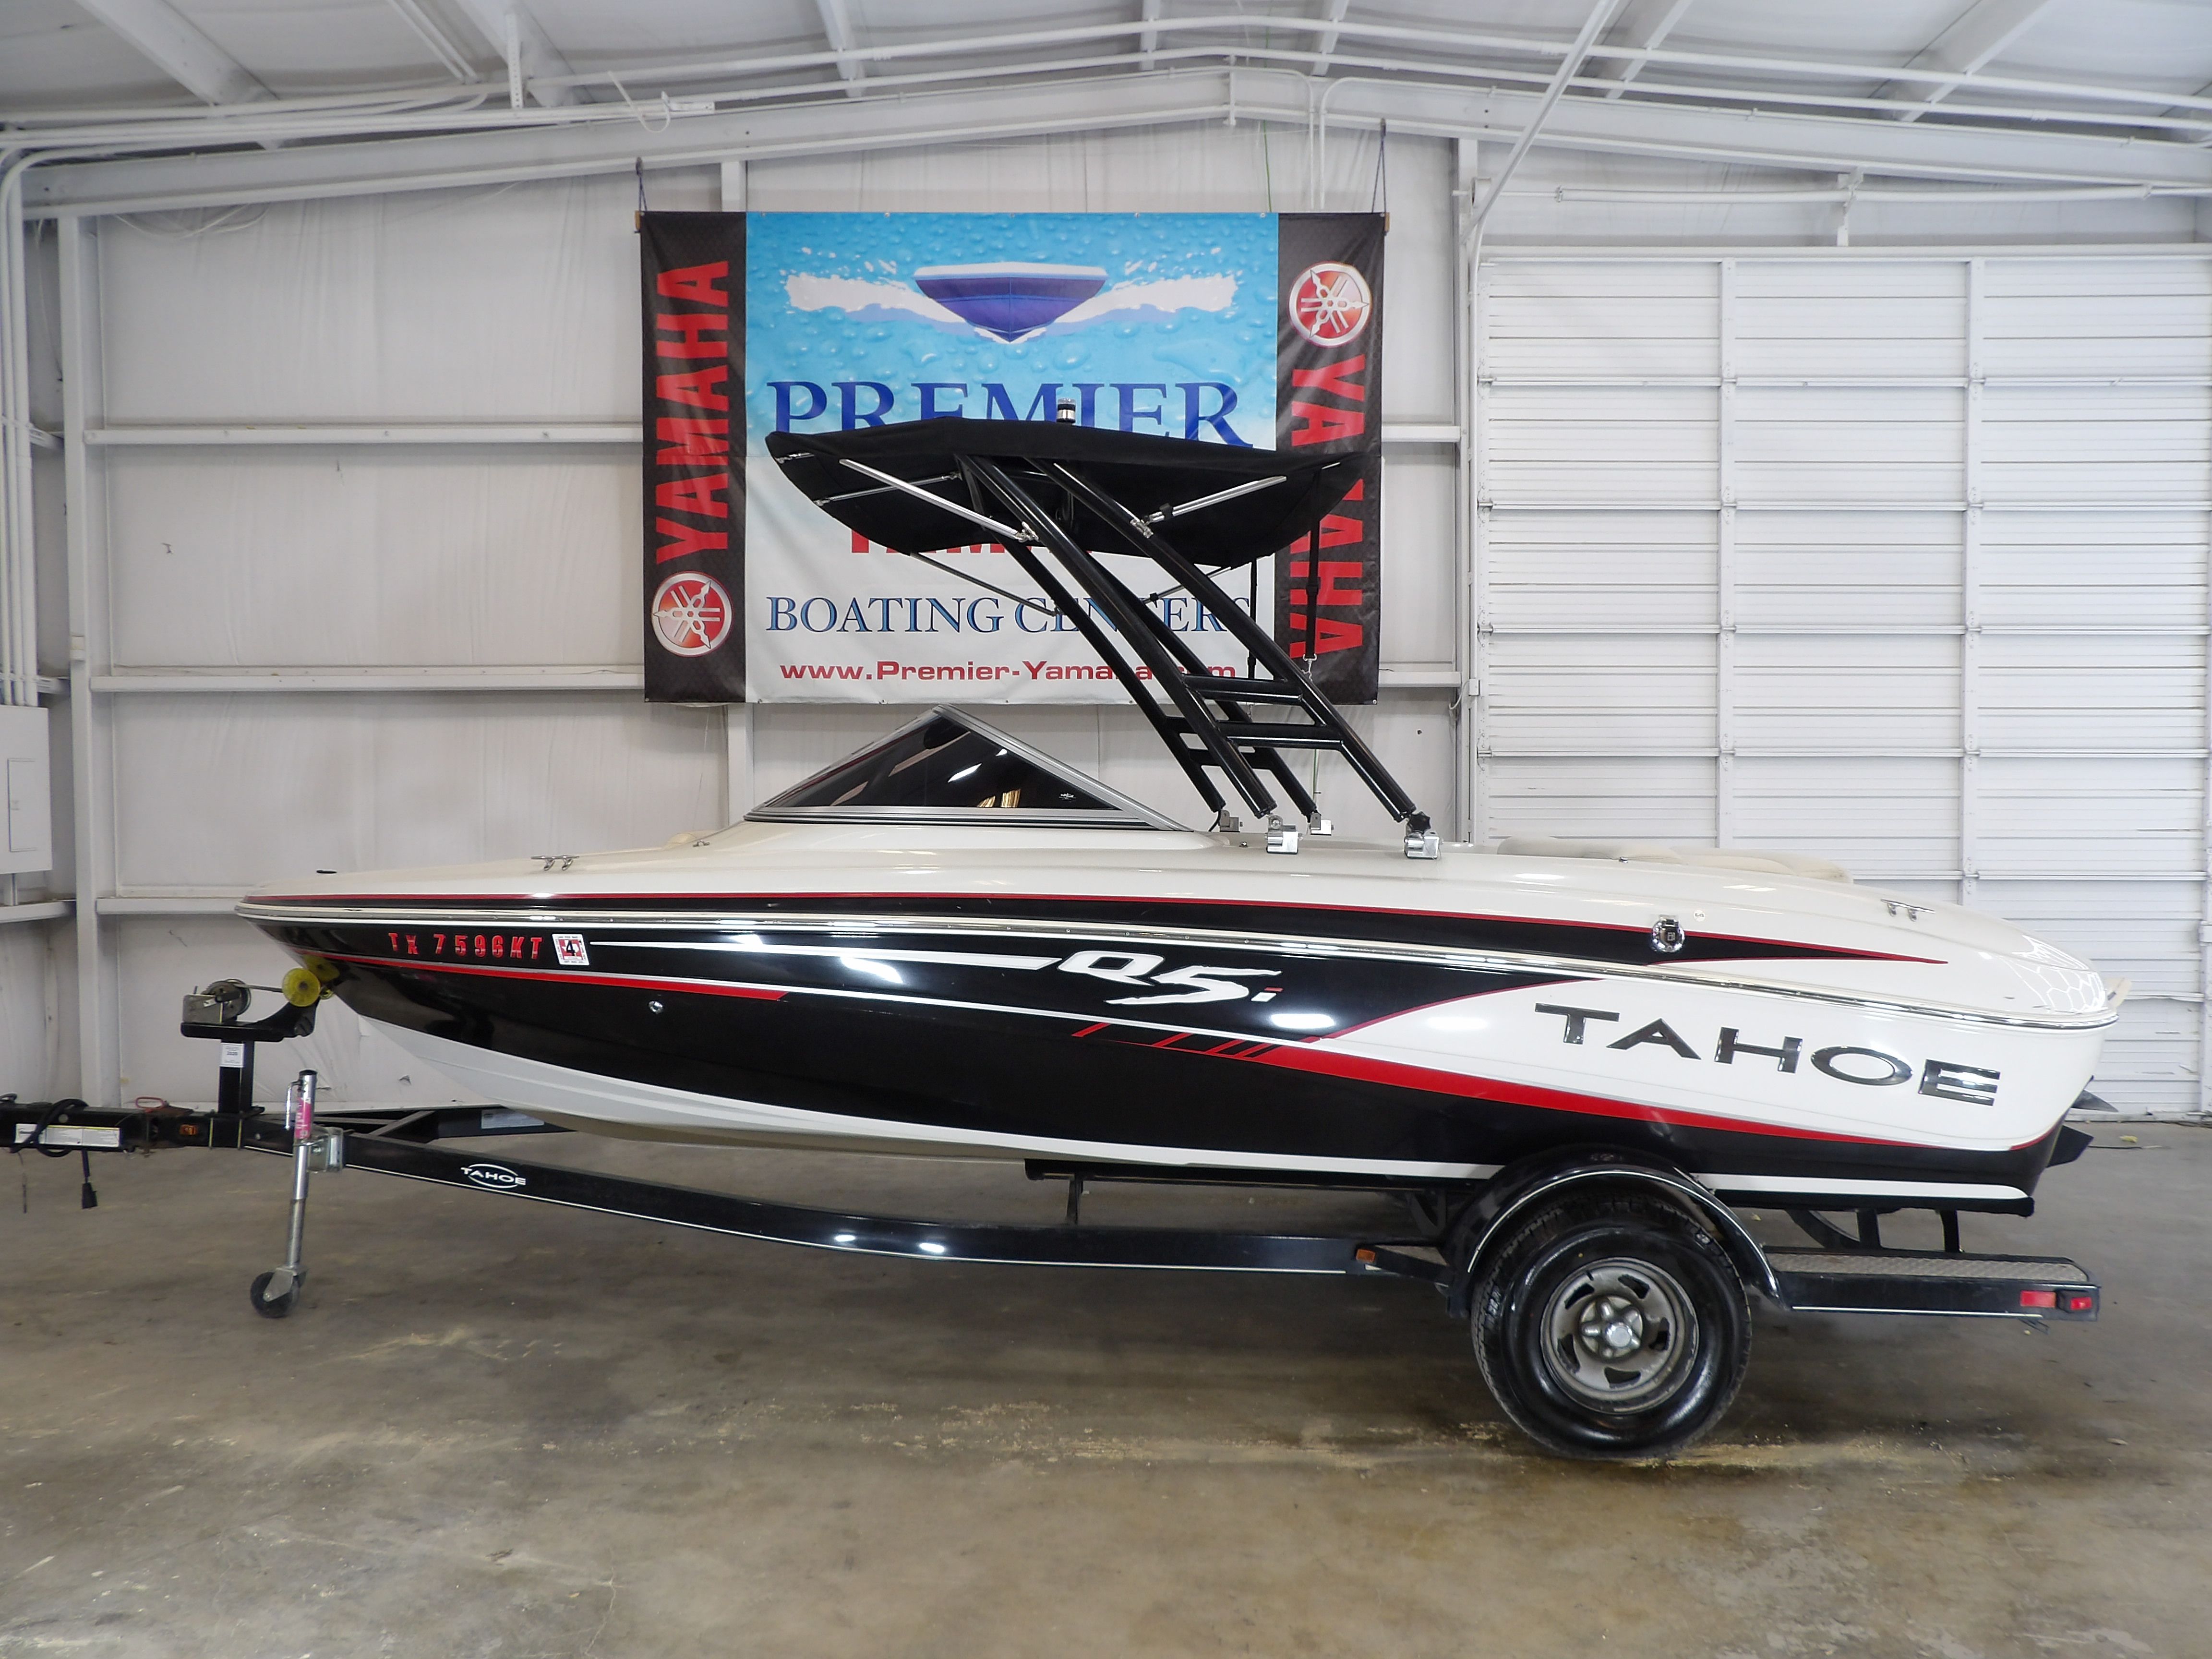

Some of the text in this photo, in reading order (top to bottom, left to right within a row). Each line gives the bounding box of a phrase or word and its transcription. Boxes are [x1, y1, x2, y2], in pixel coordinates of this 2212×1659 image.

[656, 261, 729, 565] YAMAHA
[1290, 354, 1365, 659] YAAHA
[766, 596, 1004, 633] BOATING
[566, 939, 576, 957] 4
[1534, 1002, 2001, 1106] TAHOE
[460, 1167, 527, 1186] TAHOE
